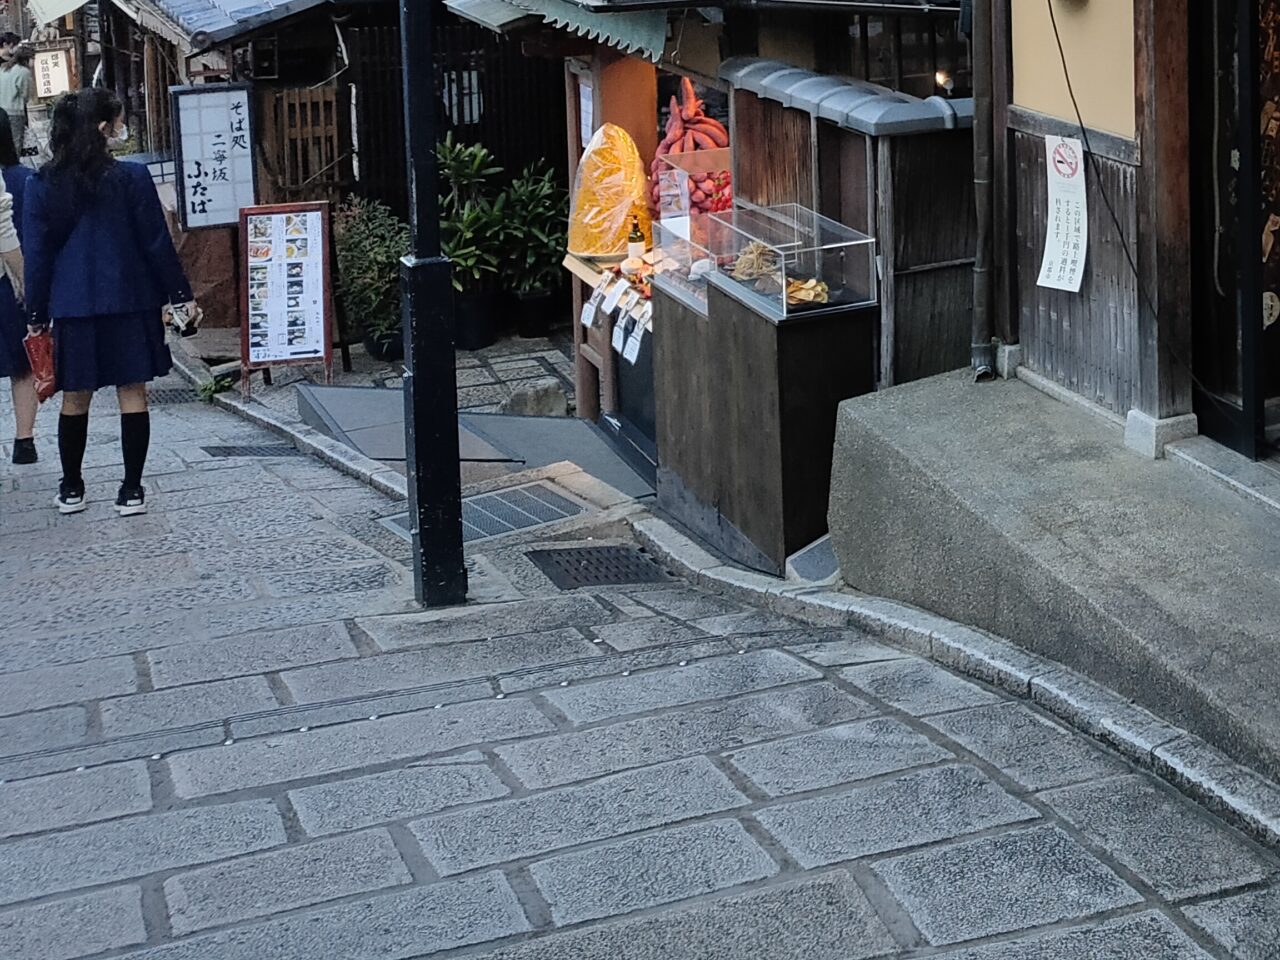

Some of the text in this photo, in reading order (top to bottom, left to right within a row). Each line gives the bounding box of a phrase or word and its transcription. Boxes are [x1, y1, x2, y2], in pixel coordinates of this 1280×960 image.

[229, 100, 249, 151] そば処
[186, 160, 213, 215] ふたば
